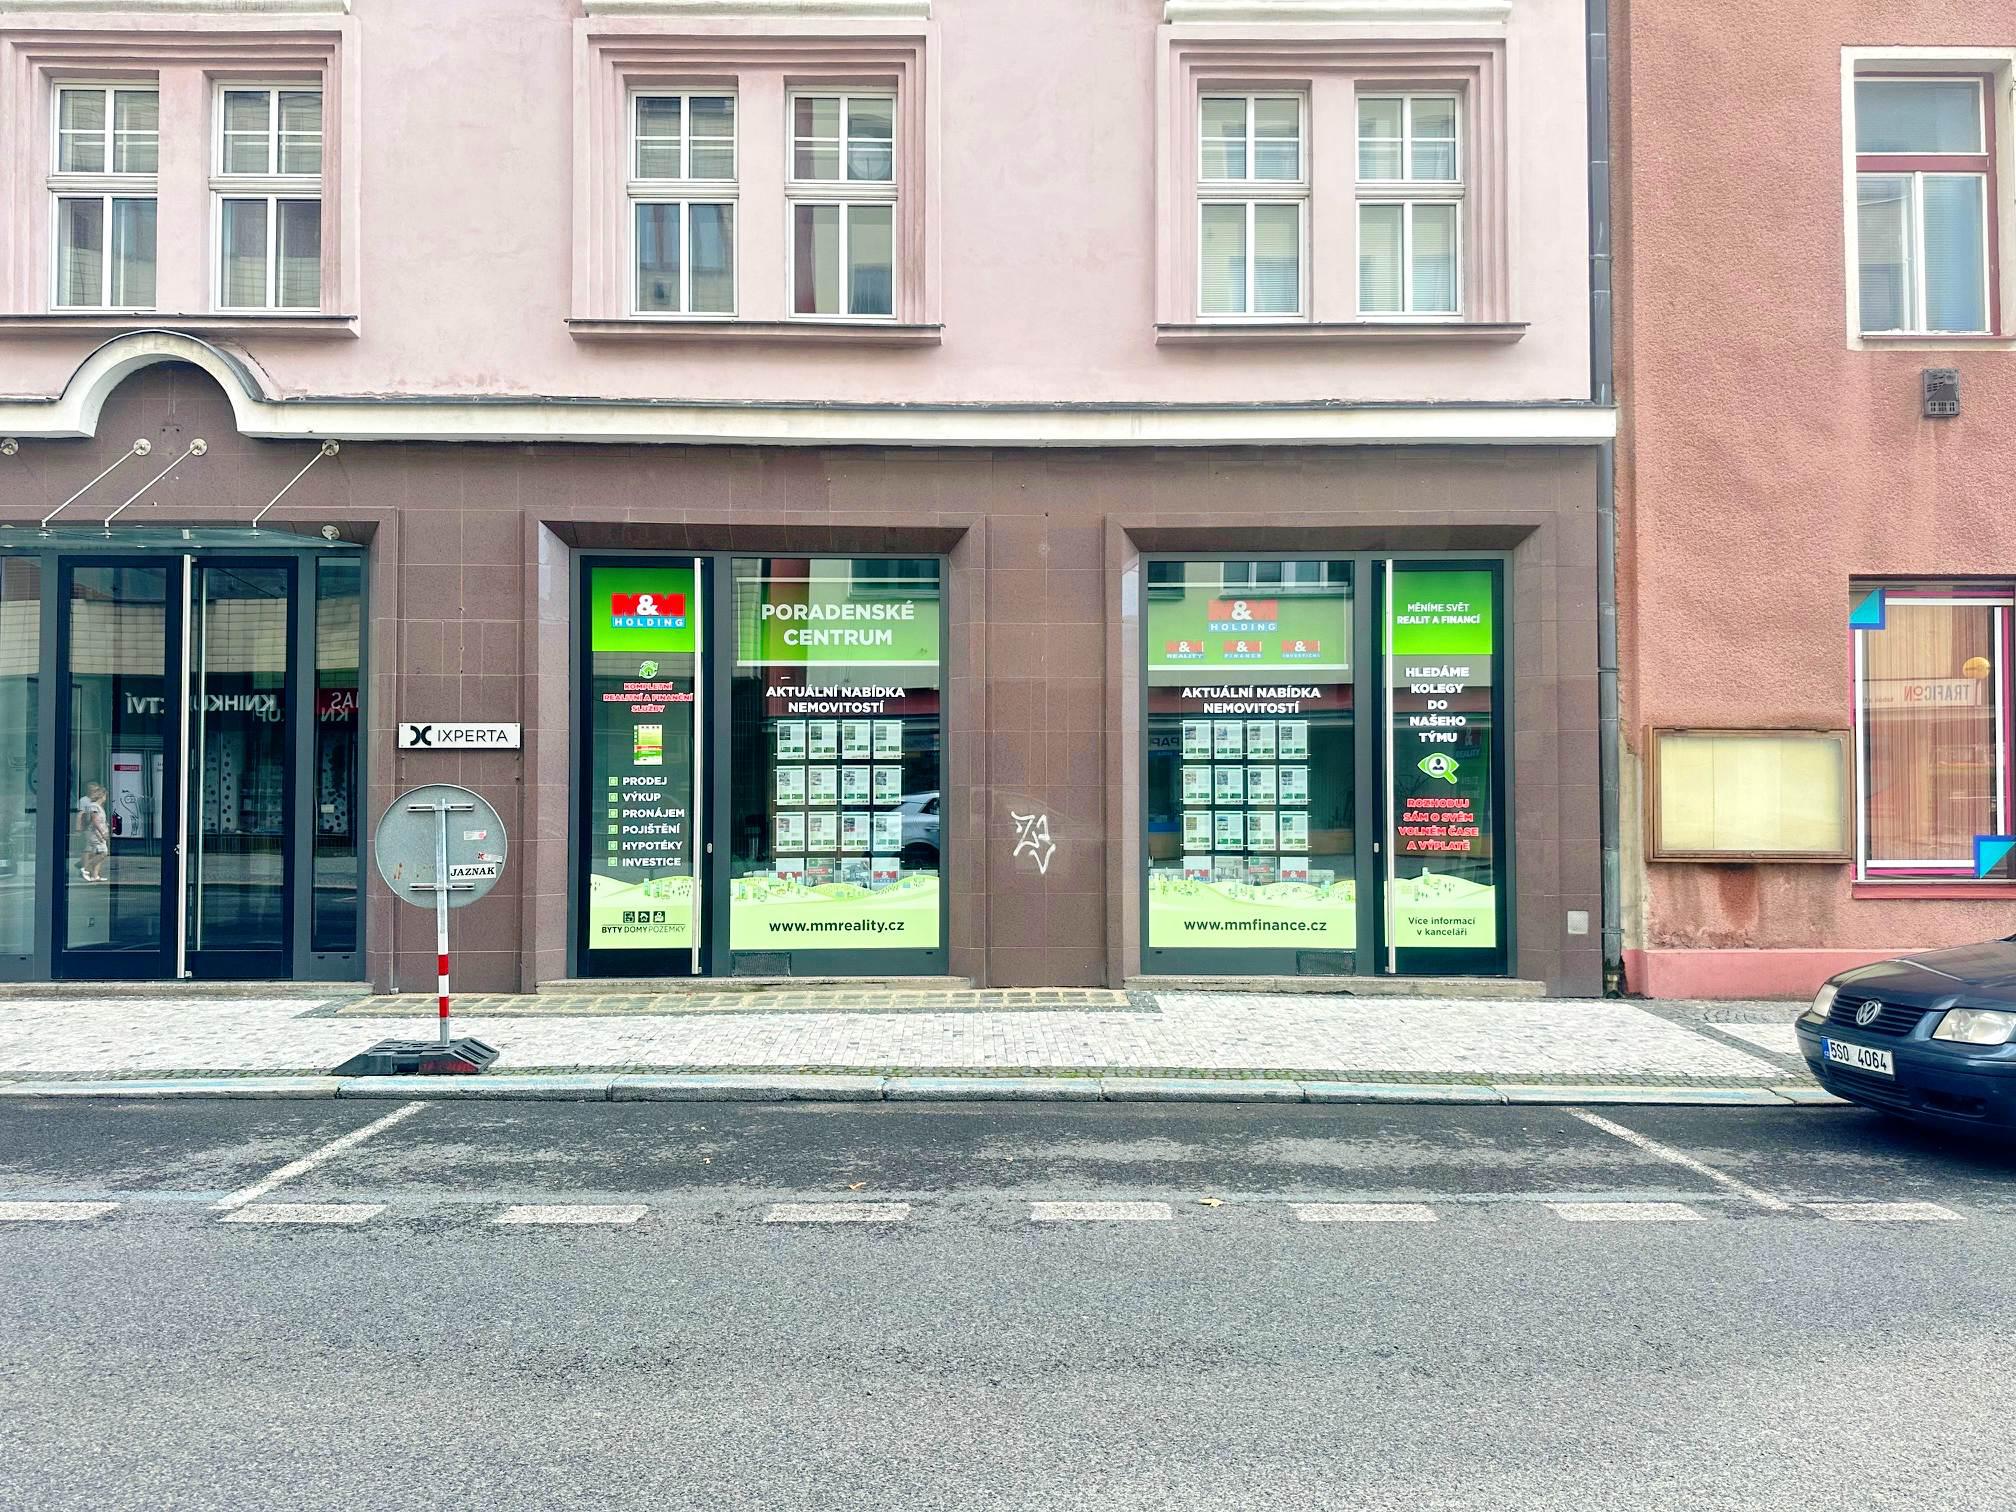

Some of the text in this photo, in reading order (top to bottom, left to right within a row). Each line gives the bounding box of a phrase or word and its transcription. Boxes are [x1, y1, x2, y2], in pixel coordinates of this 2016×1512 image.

[762, 600, 915, 620] PORADENSKÉ
[1408, 602, 1470, 612] MĚNÍME SVĚT
[614, 619, 684, 627] HOLDING
[1397, 614, 1480, 624] REALIT A FINANCÍ
[1210, 623, 1277, 631] HOLDING
[783, 629, 892, 646] CENTRUM
[1405, 665, 1470, 677] HLEDÁME
[623, 681, 674, 691] KOMPLETNÍ
[765, 684, 906, 698] AKTUÁLNÍ NABÍDKA
[1182, 685, 1321, 698] AKTUÁLNÍ NABÍDKA
[1410, 683, 1464, 694] KOLEGY
[643, 694, 652, 702] A
[630, 704, 666, 713] SLUŽBY
[788, 700, 884, 713] NEMOVITOSTÍ
[1203, 701, 1300, 714] NEMOVITOSTÍ
[1427, 700, 1448, 710] DO
[1410, 713, 1466, 727] NAŠEHO
[438, 730, 508, 742] IXPERTA
[1418, 730, 1458, 743] TÝMU
[622, 776, 668, 786] PRODEJ
[622, 791, 662, 802] VÝKUP
[1406, 798, 1470, 808] ROZHODUJ
[622, 807, 685, 818] PRONÁJEM
[1403, 811, 1474, 822] SÁM O SVÉM
[622, 823, 680, 834] POJIŠTĚNÍ
[1398, 825, 1479, 837] VOLNÉM ČASE
[622, 839, 683, 850] HYPOTÉKY
[1407, 839, 1470, 851] A VÝPLATĚ
[622, 857, 681, 866] INVESTICE
[450, 866, 495, 877] JAZNAK
[1184, 918, 1327, 931] www.mmfinance.cz
[1408, 916, 1476, 925] Více informací
[602, 925, 686, 934] BYTY DOMY POZEMKY
[769, 919, 905, 934] www.mmreality.cz
[1416, 927, 1468, 936] v kanceláři
[1857, 1048, 1887, 1071] 4064
